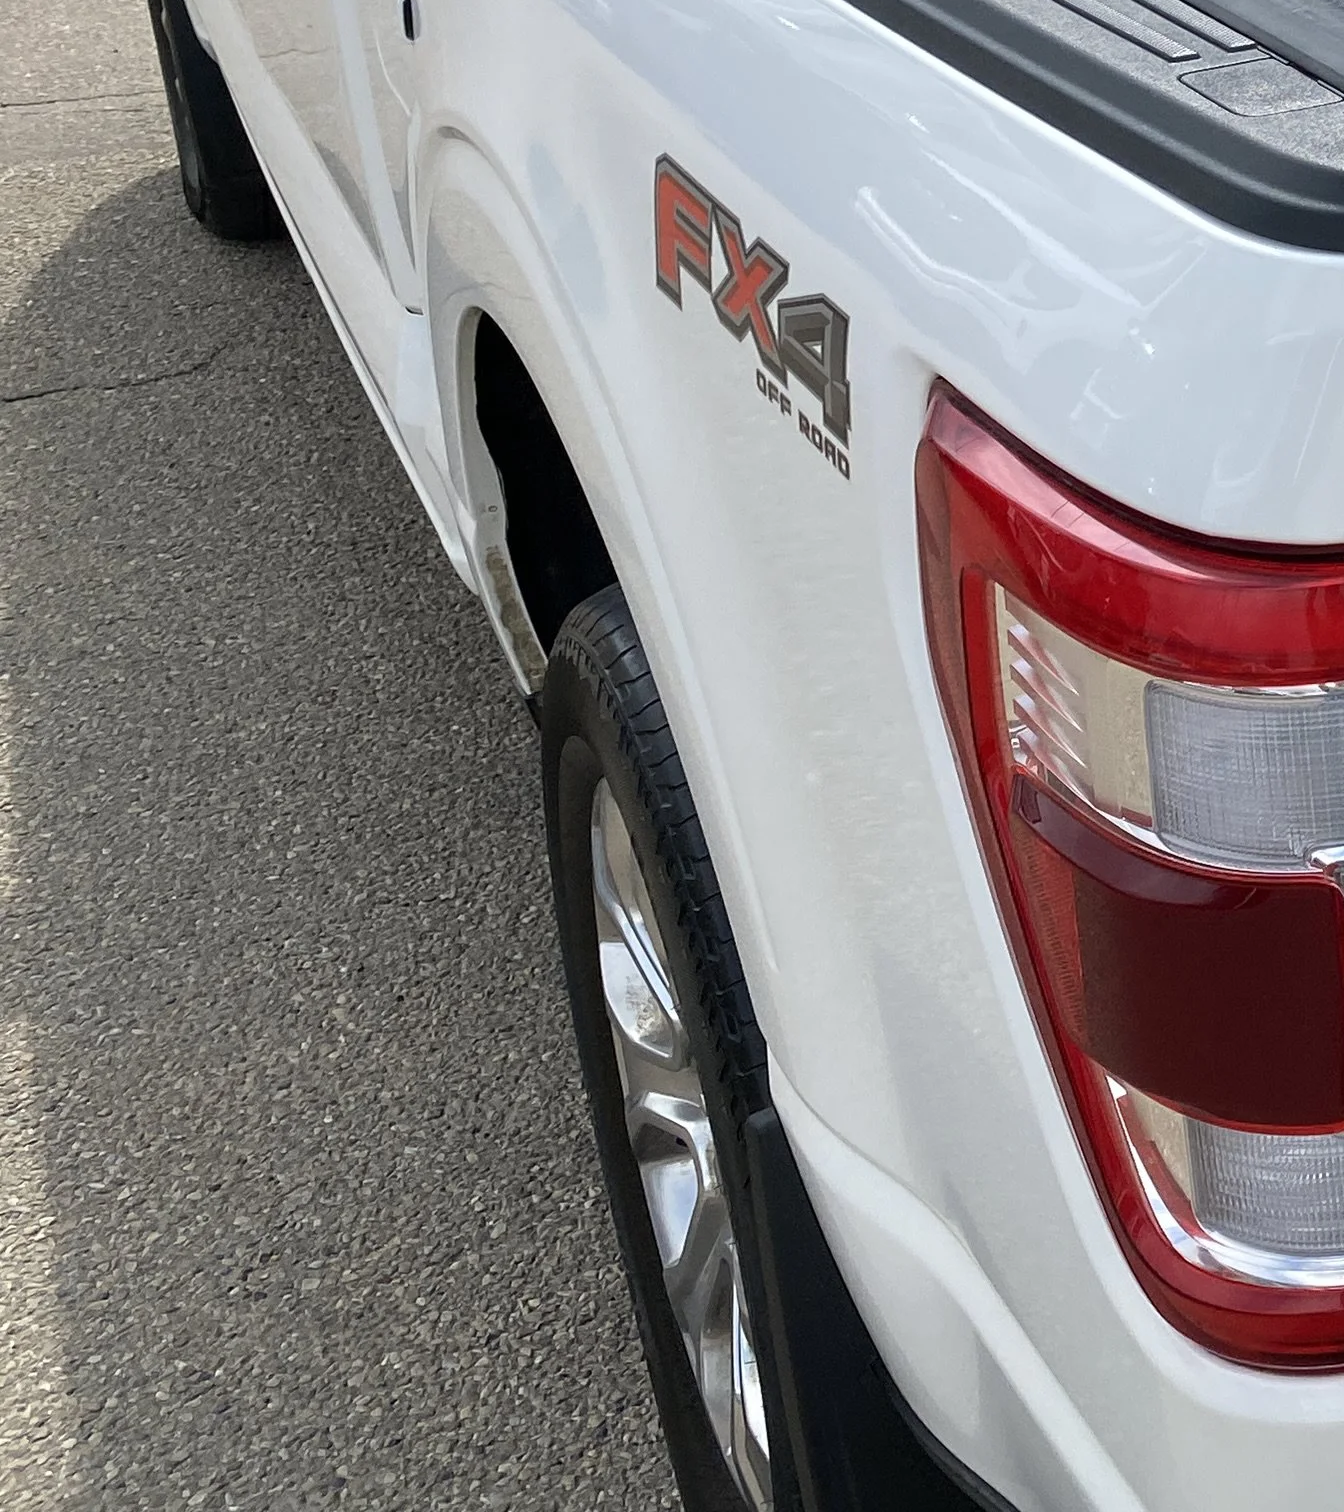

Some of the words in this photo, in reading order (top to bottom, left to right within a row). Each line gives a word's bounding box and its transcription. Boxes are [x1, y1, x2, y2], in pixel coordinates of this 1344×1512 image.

[655, 152, 852, 450] FX4
[756, 368, 792, 417] OFF
[798, 409, 851, 481] ROAD
